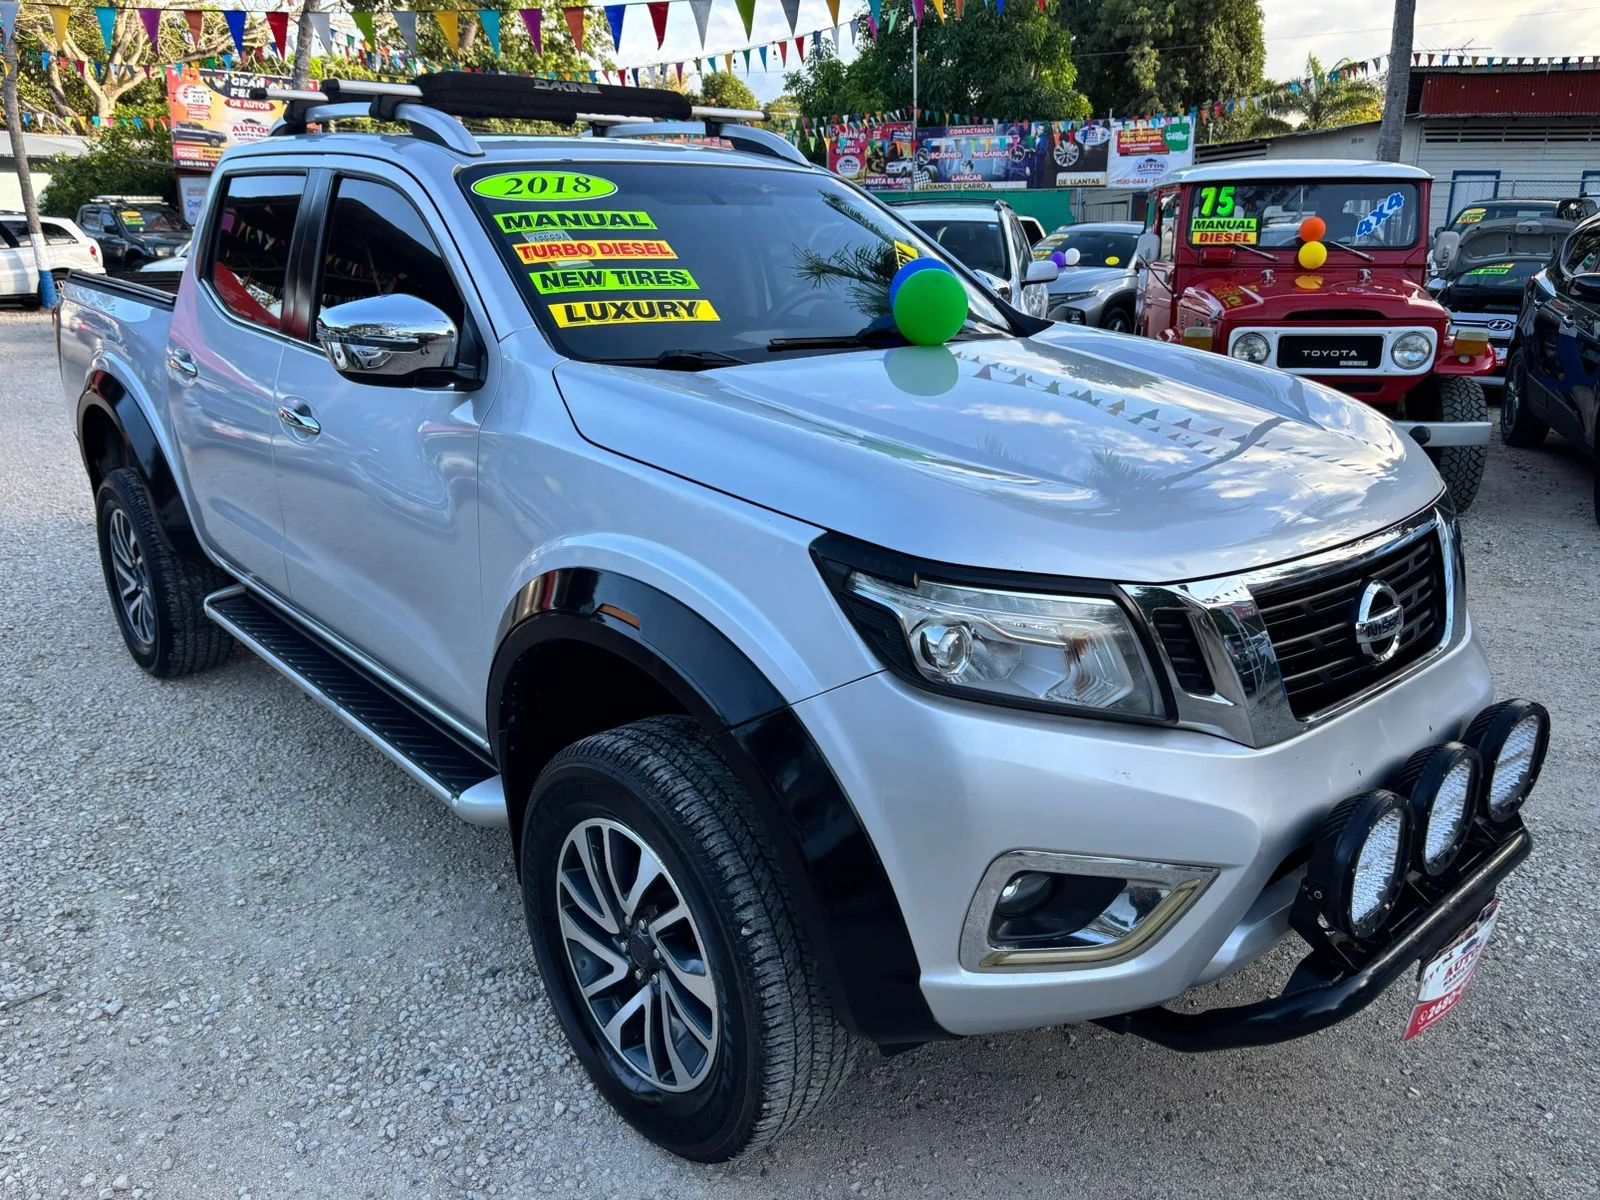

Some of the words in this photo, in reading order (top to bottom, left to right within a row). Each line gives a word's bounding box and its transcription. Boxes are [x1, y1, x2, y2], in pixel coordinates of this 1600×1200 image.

[231, 77, 266, 88] GRAN
[533, 79, 602, 94] DAKINE
[243, 100, 270, 110] AUTOS
[931, 151, 962, 159] SCANNER
[951, 174, 982, 182] LAVACAR
[504, 177, 592, 196] 2018
[919, 183, 952, 191] LLEVAMOS
[1200, 186, 1236, 217] 75
[502, 213, 652, 230] MANUAL
[1193, 220, 1255, 230] MANUAL
[1199, 233, 1251, 243] DIESEL
[517, 242, 595, 260] TURBO
[599, 241, 672, 256] DIESEL
[539, 270, 605, 290] NEW
[611, 269, 690, 286] TIRES
[564, 300, 700, 323] LUXURY
